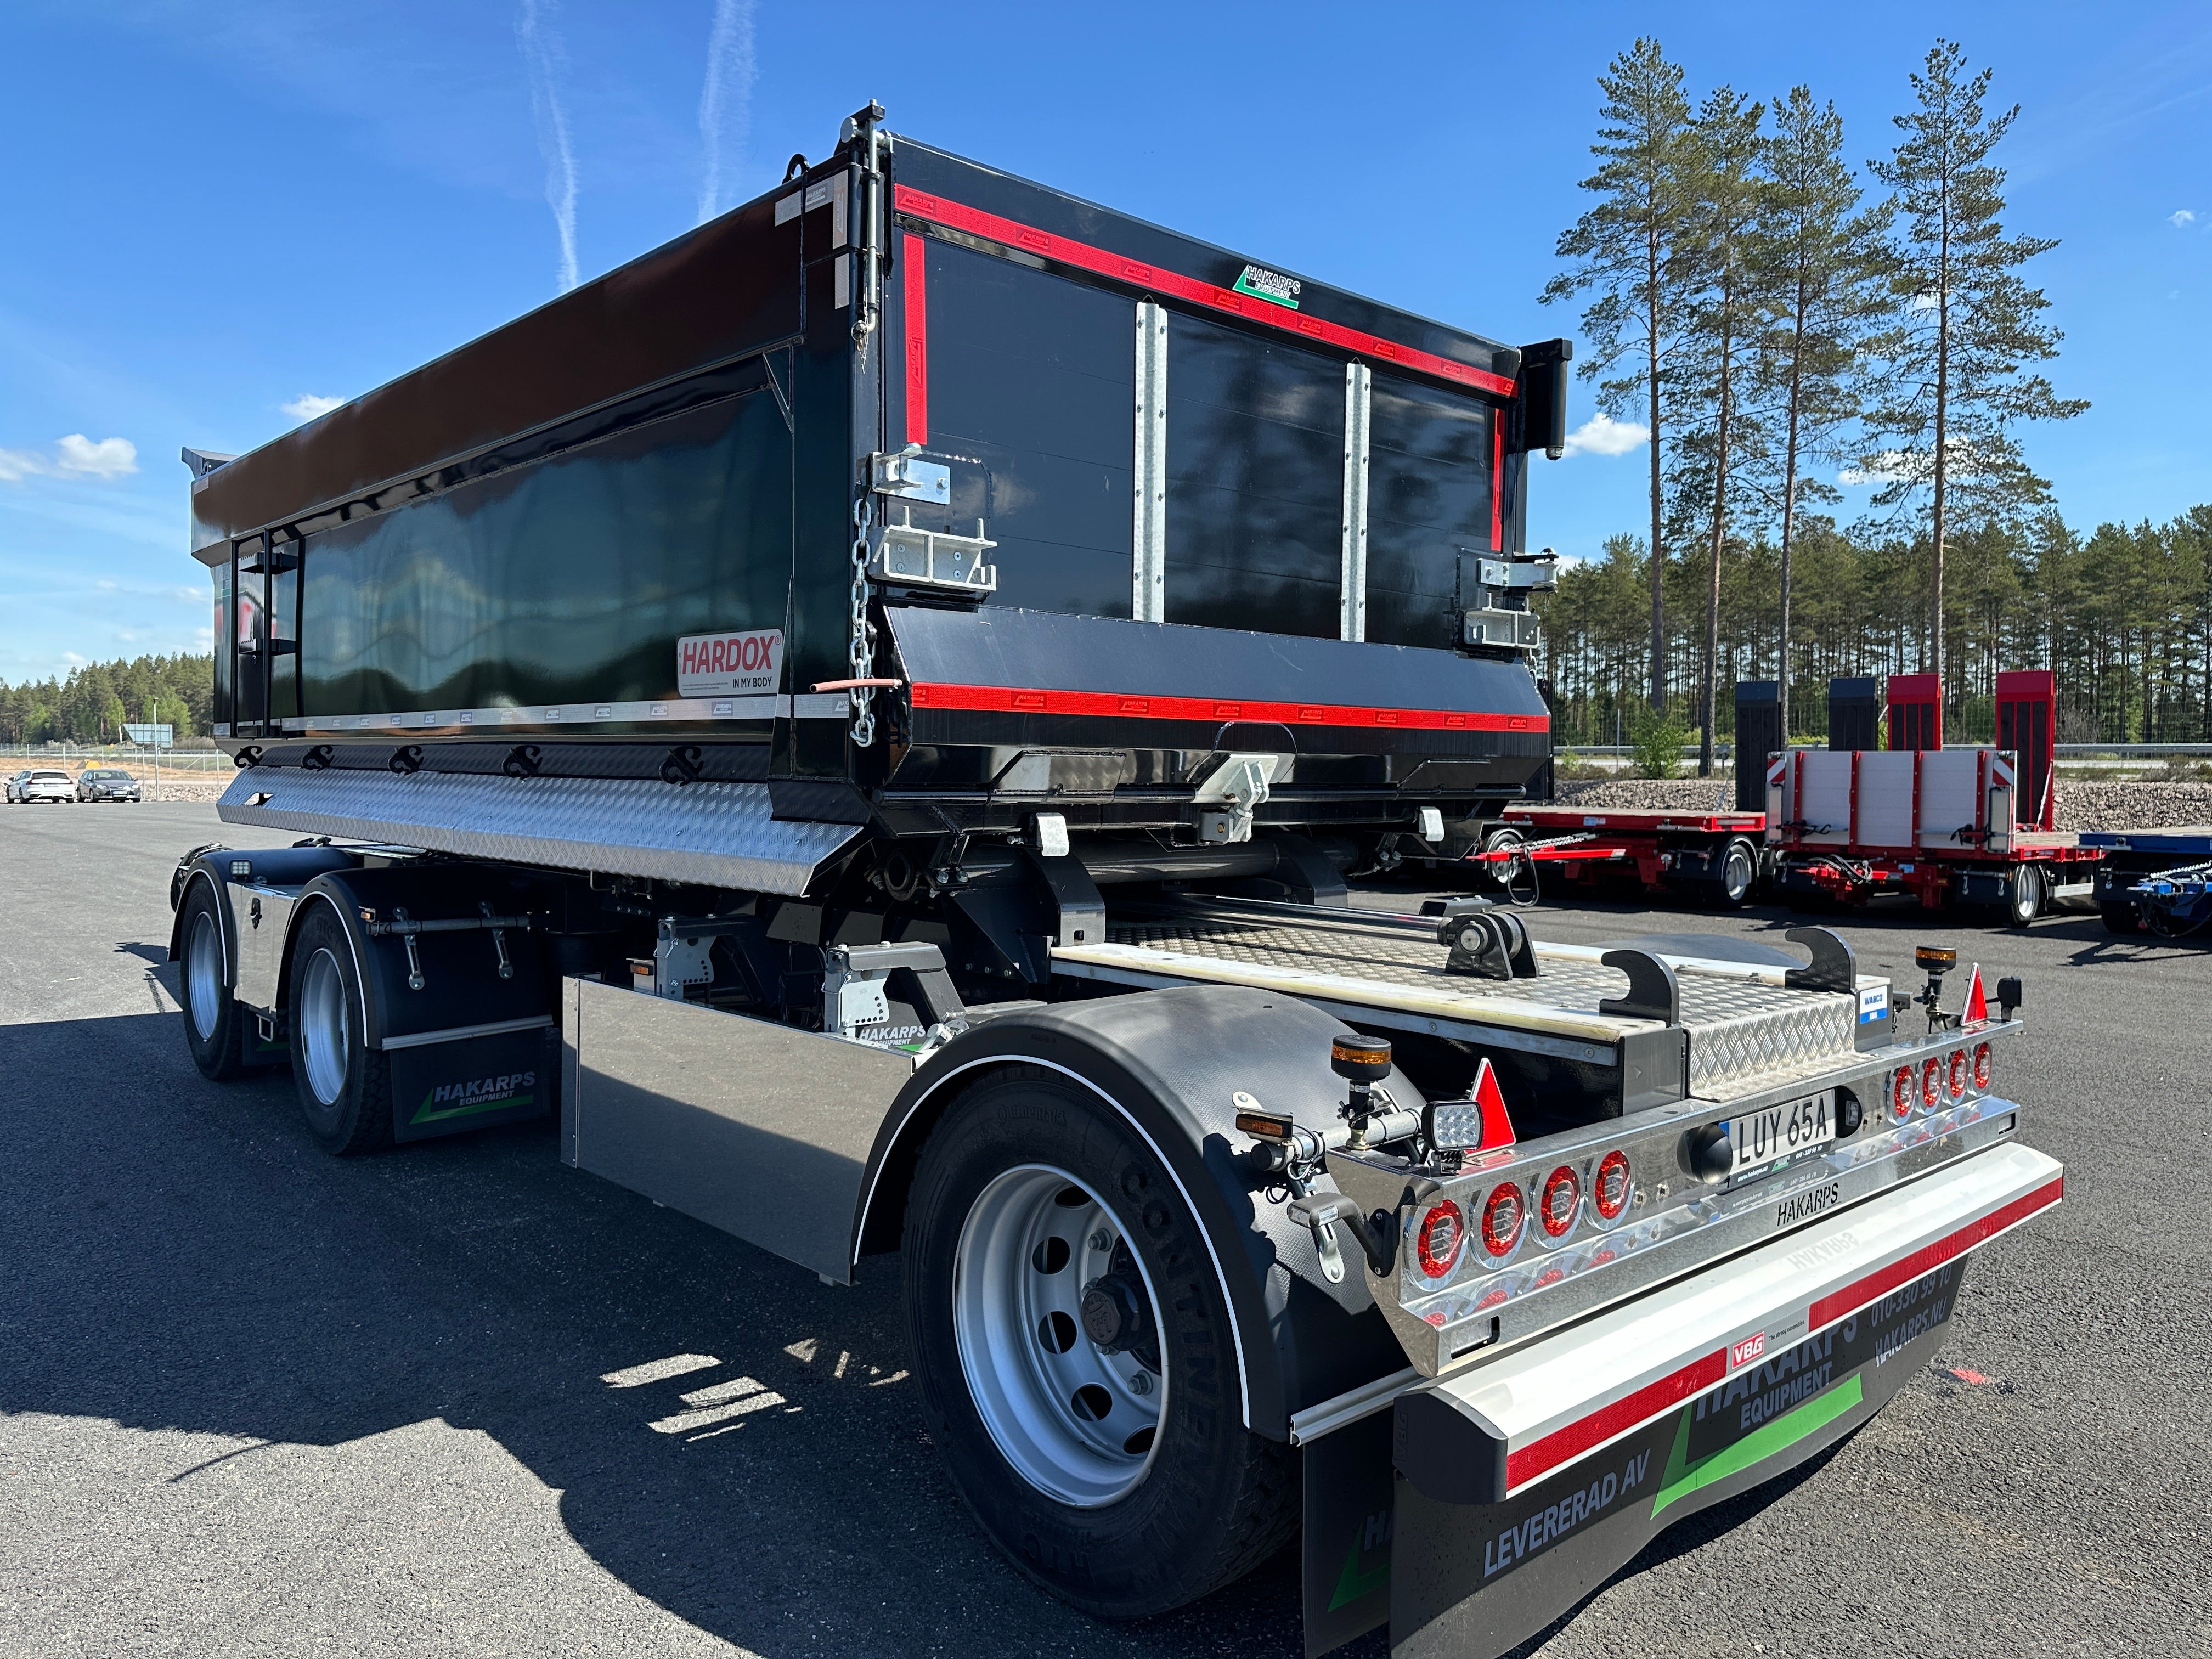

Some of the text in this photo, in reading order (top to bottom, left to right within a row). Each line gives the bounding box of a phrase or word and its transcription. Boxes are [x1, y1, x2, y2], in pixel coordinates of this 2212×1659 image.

[1247, 265, 1301, 295] HAKARPS
[1255, 282, 1291, 298] EQUIPMENT
[732, 678, 740, 688] IN
[741, 678, 751, 687] MY
[753, 676, 772, 687] BODY
[1865, 994, 1883, 1005] WABCO
[860, 1025, 926, 1041] HAKARPS
[435, 1071, 535, 1102] HAKARPS
[459, 1090, 515, 1106] EQUIPMENT
[1739, 1097, 1827, 1165] LUY 65A
[1777, 1182, 1839, 1226] HAKARPS
[1871, 1264, 1951, 1327] 010-330 99 10
[1875, 1296, 1947, 1368] HAKARPS.NU
[1734, 1335, 1763, 1363] VBG
[1740, 1361, 1832, 1430] EQUIPMENT
[1395, 1410, 1409, 1462] VBG
[1483, 1471, 1616, 1578] LEVERERAD
[1620, 1448, 1650, 1496] AV
